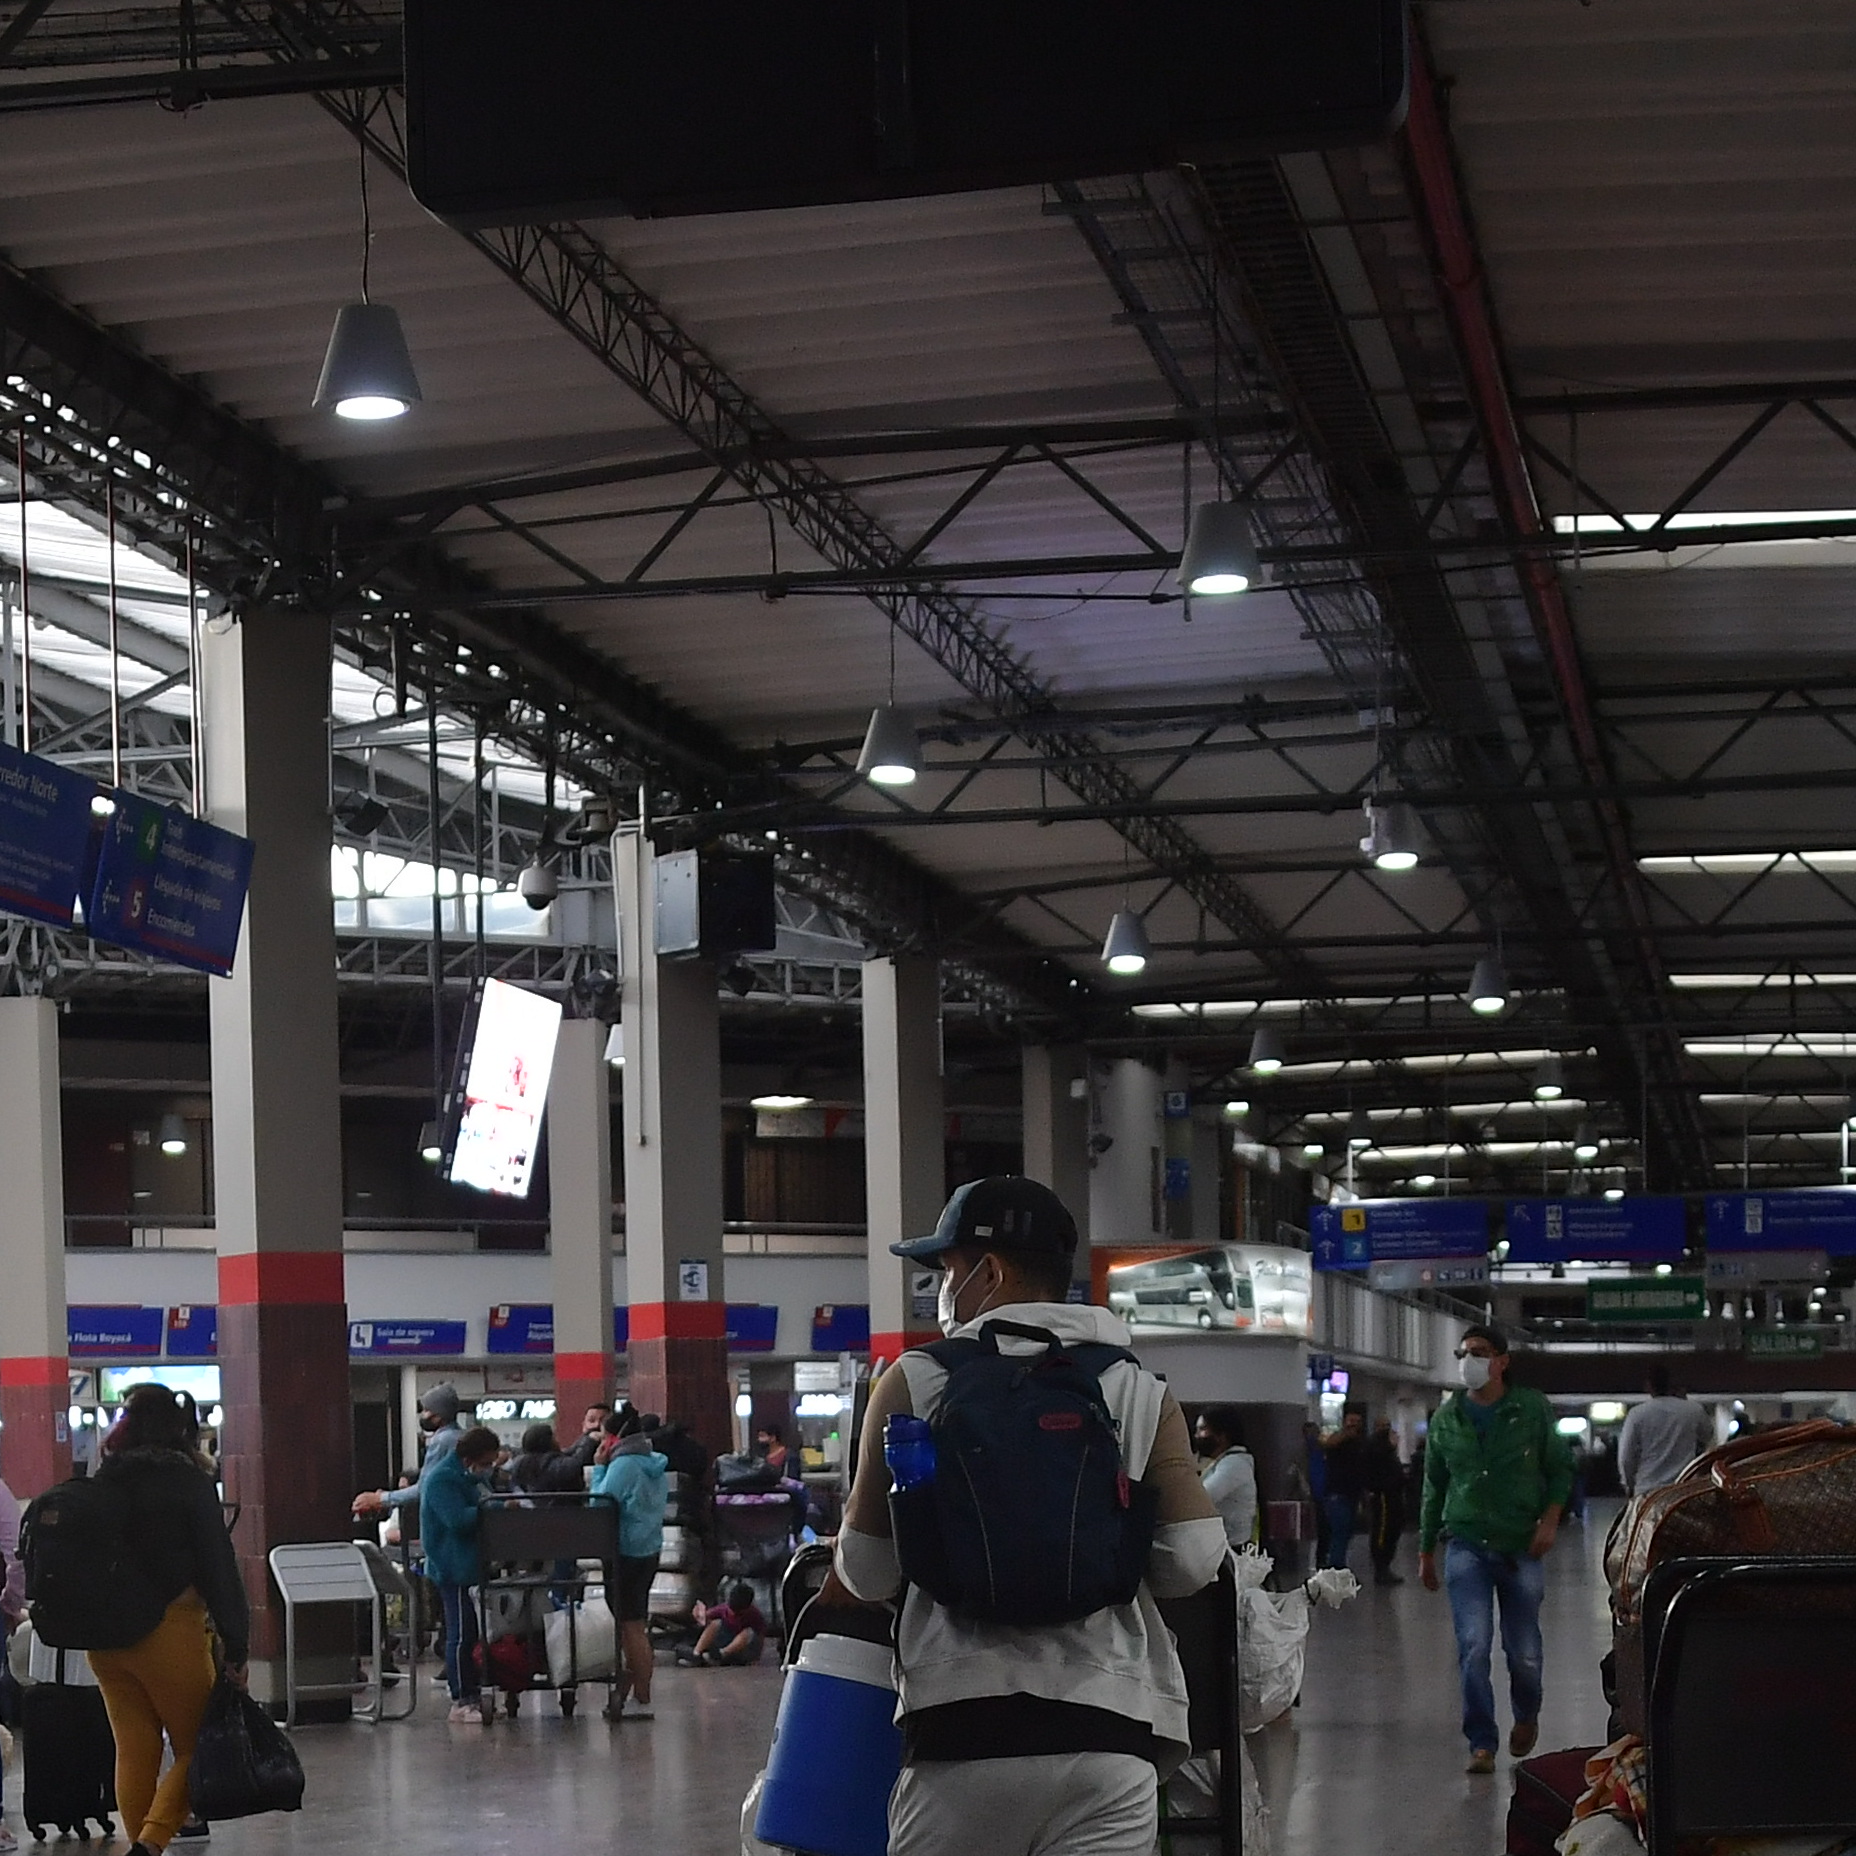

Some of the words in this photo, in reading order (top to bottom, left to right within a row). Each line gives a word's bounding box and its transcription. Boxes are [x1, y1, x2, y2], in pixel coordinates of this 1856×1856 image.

[30, 773, 61, 803] Norte
[145, 822, 158, 851] 4
[130, 890, 143, 919] 5
